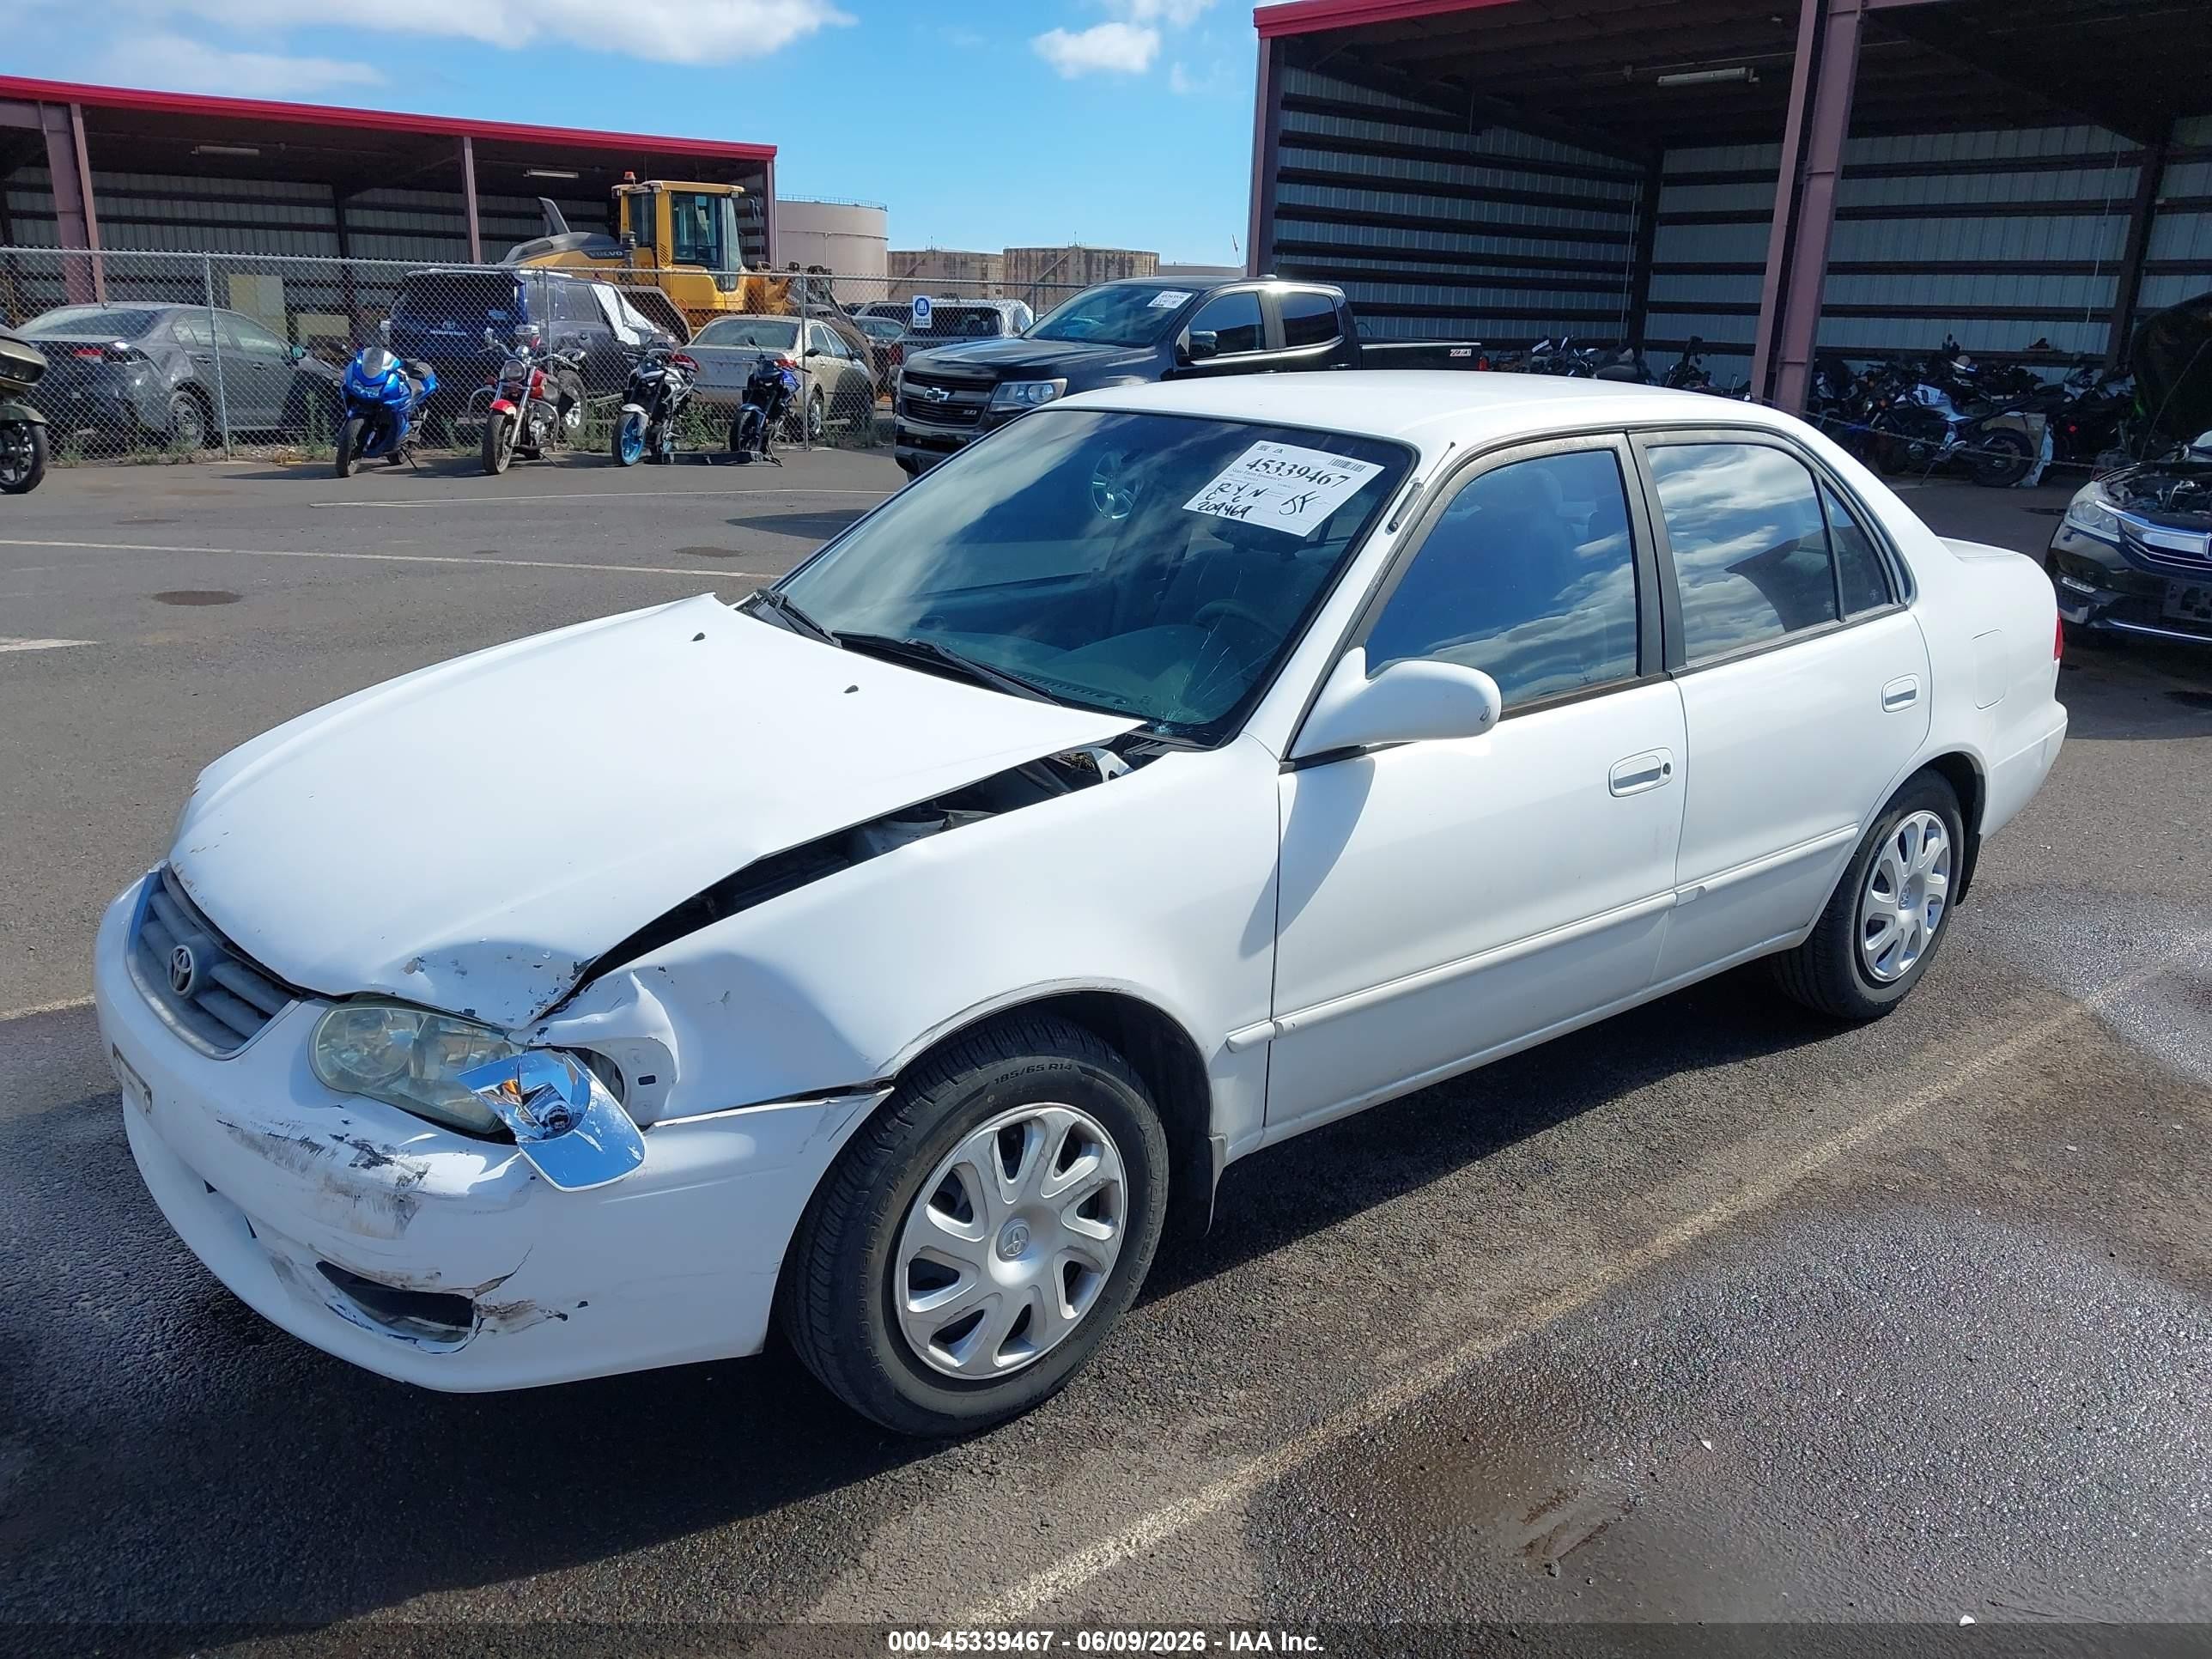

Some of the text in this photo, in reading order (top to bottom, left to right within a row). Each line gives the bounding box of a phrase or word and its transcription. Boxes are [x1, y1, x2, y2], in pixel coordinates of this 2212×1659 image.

[1246, 458, 1352, 489] 45339467
[994, 1063, 1073, 1085] 185/65 R14
